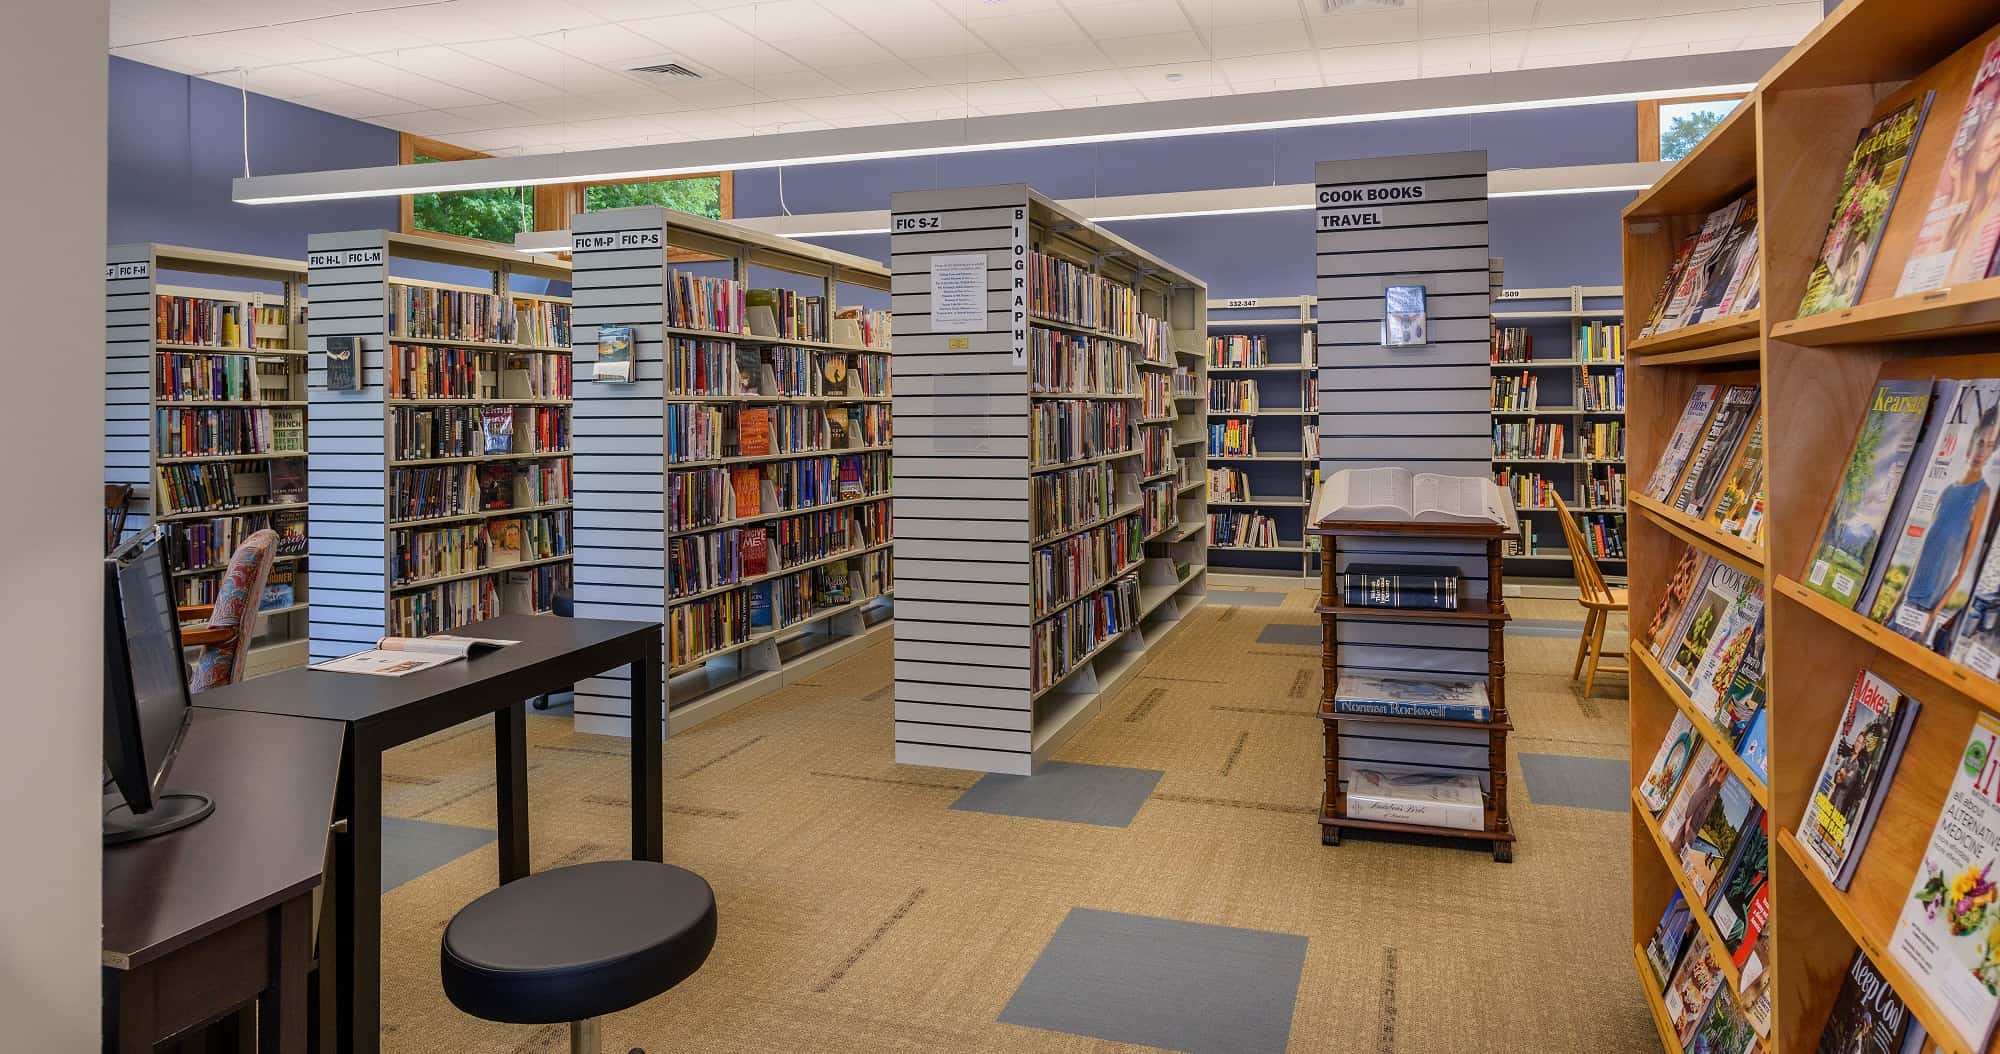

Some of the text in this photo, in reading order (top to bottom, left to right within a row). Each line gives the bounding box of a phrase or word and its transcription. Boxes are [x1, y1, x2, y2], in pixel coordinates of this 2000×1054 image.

[1320, 186, 1423, 203] COOK BOOKS
[896, 216, 939, 230] FIC S-Z
[1321, 213, 1381, 227] TRAVEL
[575, 237, 614, 248] FIC M-P
[621, 234, 659, 245] FIC P-S
[310, 255, 341, 265] FIC H-L
[348, 252, 381, 262] FIC L-M
[120, 265, 146, 276] FIC F-H
[1014, 209, 1024, 358] BIOGRAPHY
[1341, 702, 1447, 719] Norman Rockwell
[1851, 951, 1880, 1006] Keep
